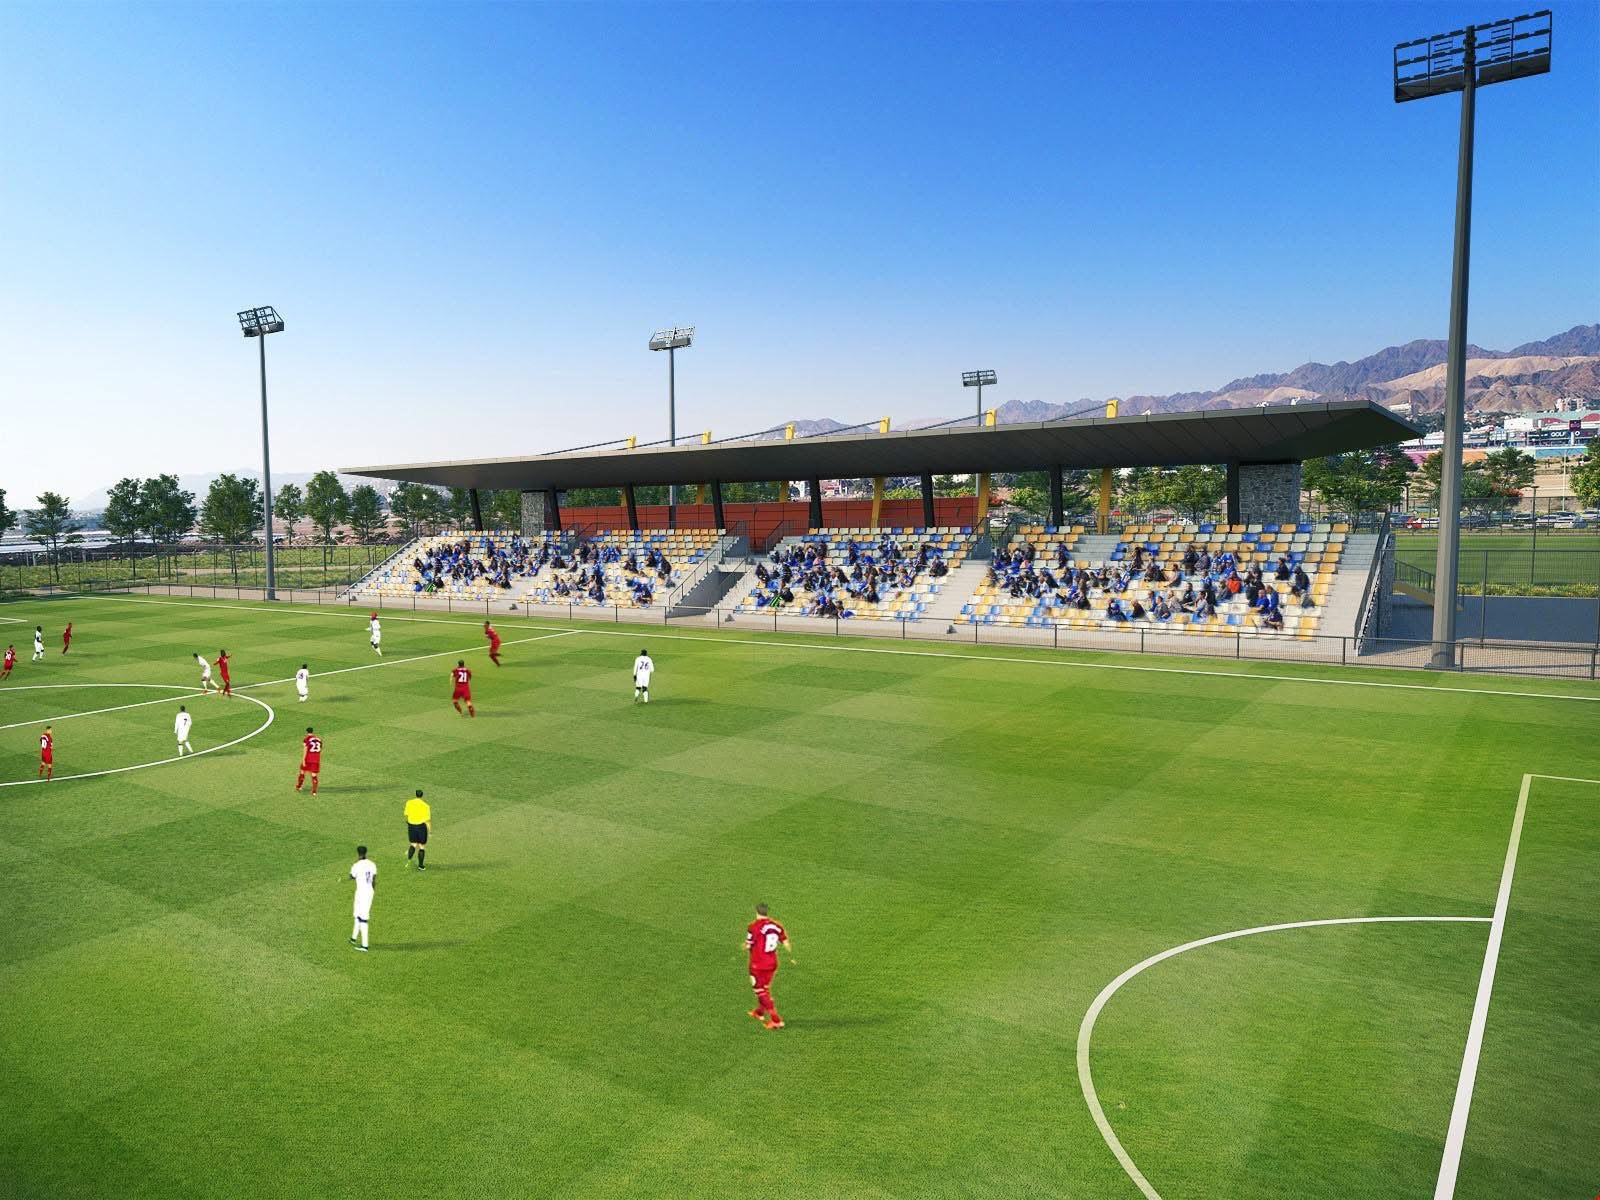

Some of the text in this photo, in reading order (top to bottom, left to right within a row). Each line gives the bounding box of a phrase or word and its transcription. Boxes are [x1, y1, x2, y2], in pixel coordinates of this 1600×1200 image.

[458, 671, 467, 682] 21
[183, 718, 188, 726] 7
[309, 741, 320, 752] 23
